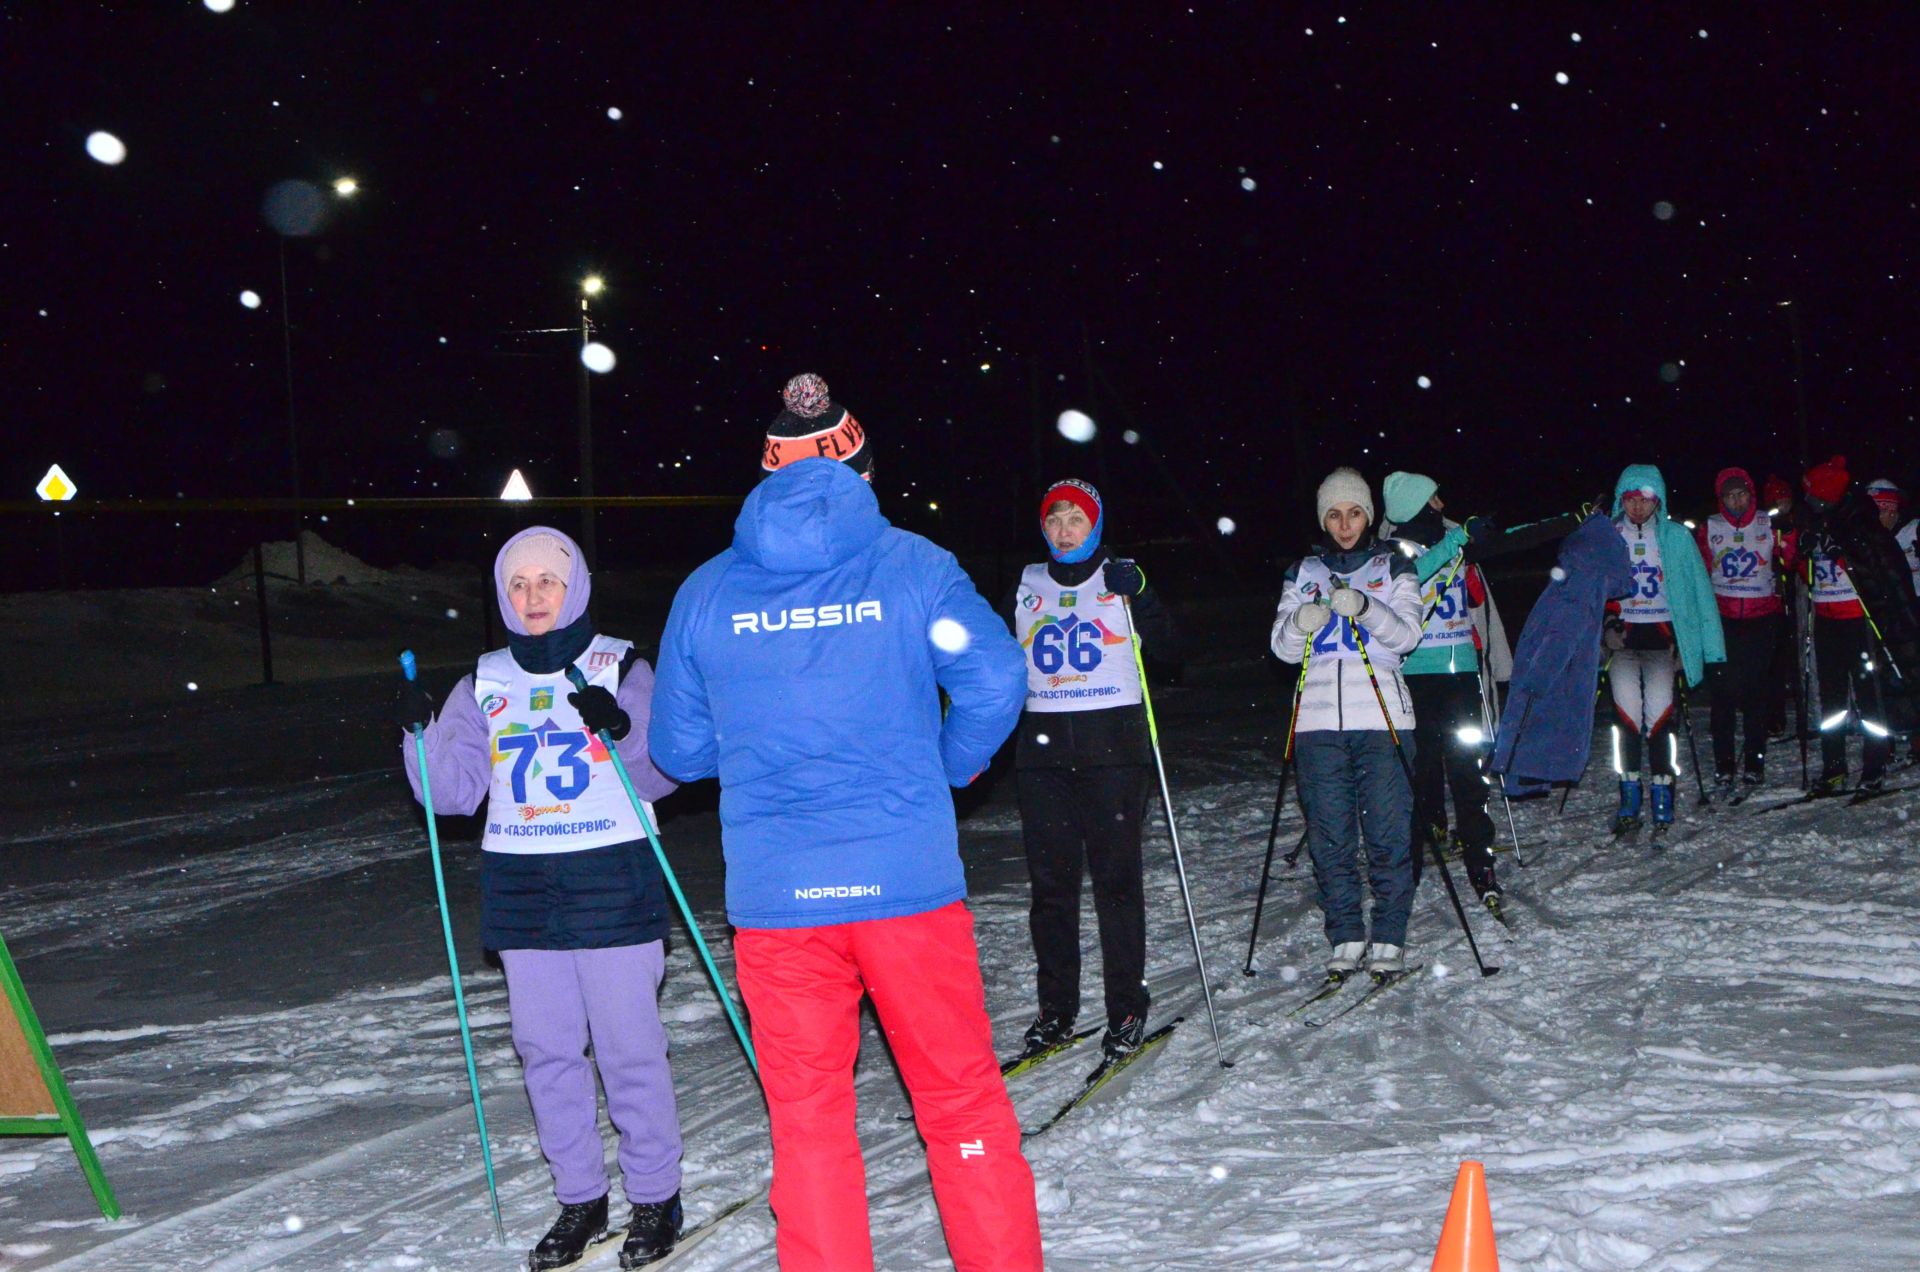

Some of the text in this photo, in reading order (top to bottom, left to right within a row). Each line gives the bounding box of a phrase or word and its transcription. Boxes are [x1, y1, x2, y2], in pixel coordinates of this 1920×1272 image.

[1721, 551, 1758, 578] 62
[1435, 579, 1468, 620] 51
[731, 600, 882, 635] RUSSIA
[1032, 621, 1102, 675] 66
[498, 730, 590, 803] 73
[504, 818, 617, 837] «ГАЗСТРОЙСЕРВИС»
[794, 885, 881, 900] NORDSKI
